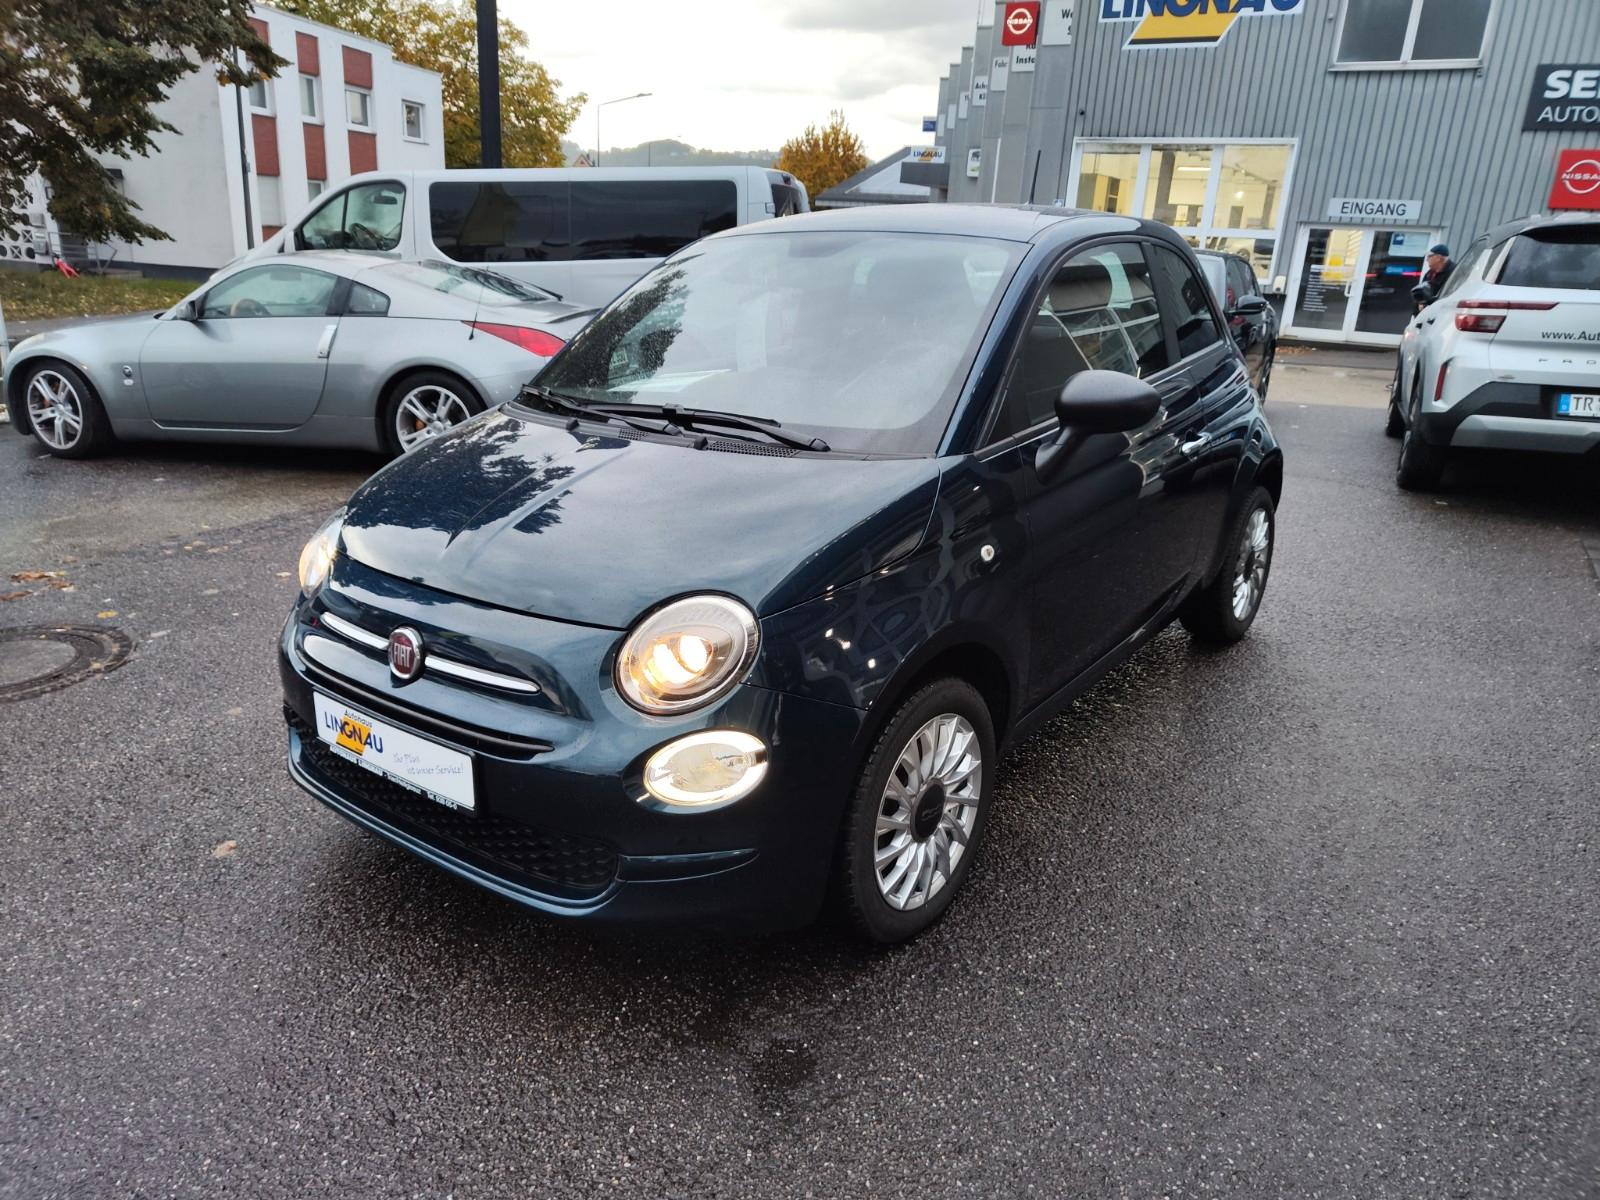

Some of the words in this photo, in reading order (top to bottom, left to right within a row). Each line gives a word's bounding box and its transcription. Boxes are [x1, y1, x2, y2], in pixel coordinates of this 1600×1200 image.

[1007, 17, 1033, 25] NISSAN
[1543, 69, 1600, 99] SE
[1537, 105, 1600, 122] AUTO
[1340, 201, 1407, 216] EINGANG
[1573, 396, 1593, 411] TR
[394, 642, 411, 669] FIAT
[325, 711, 384, 754] LINGNAU
